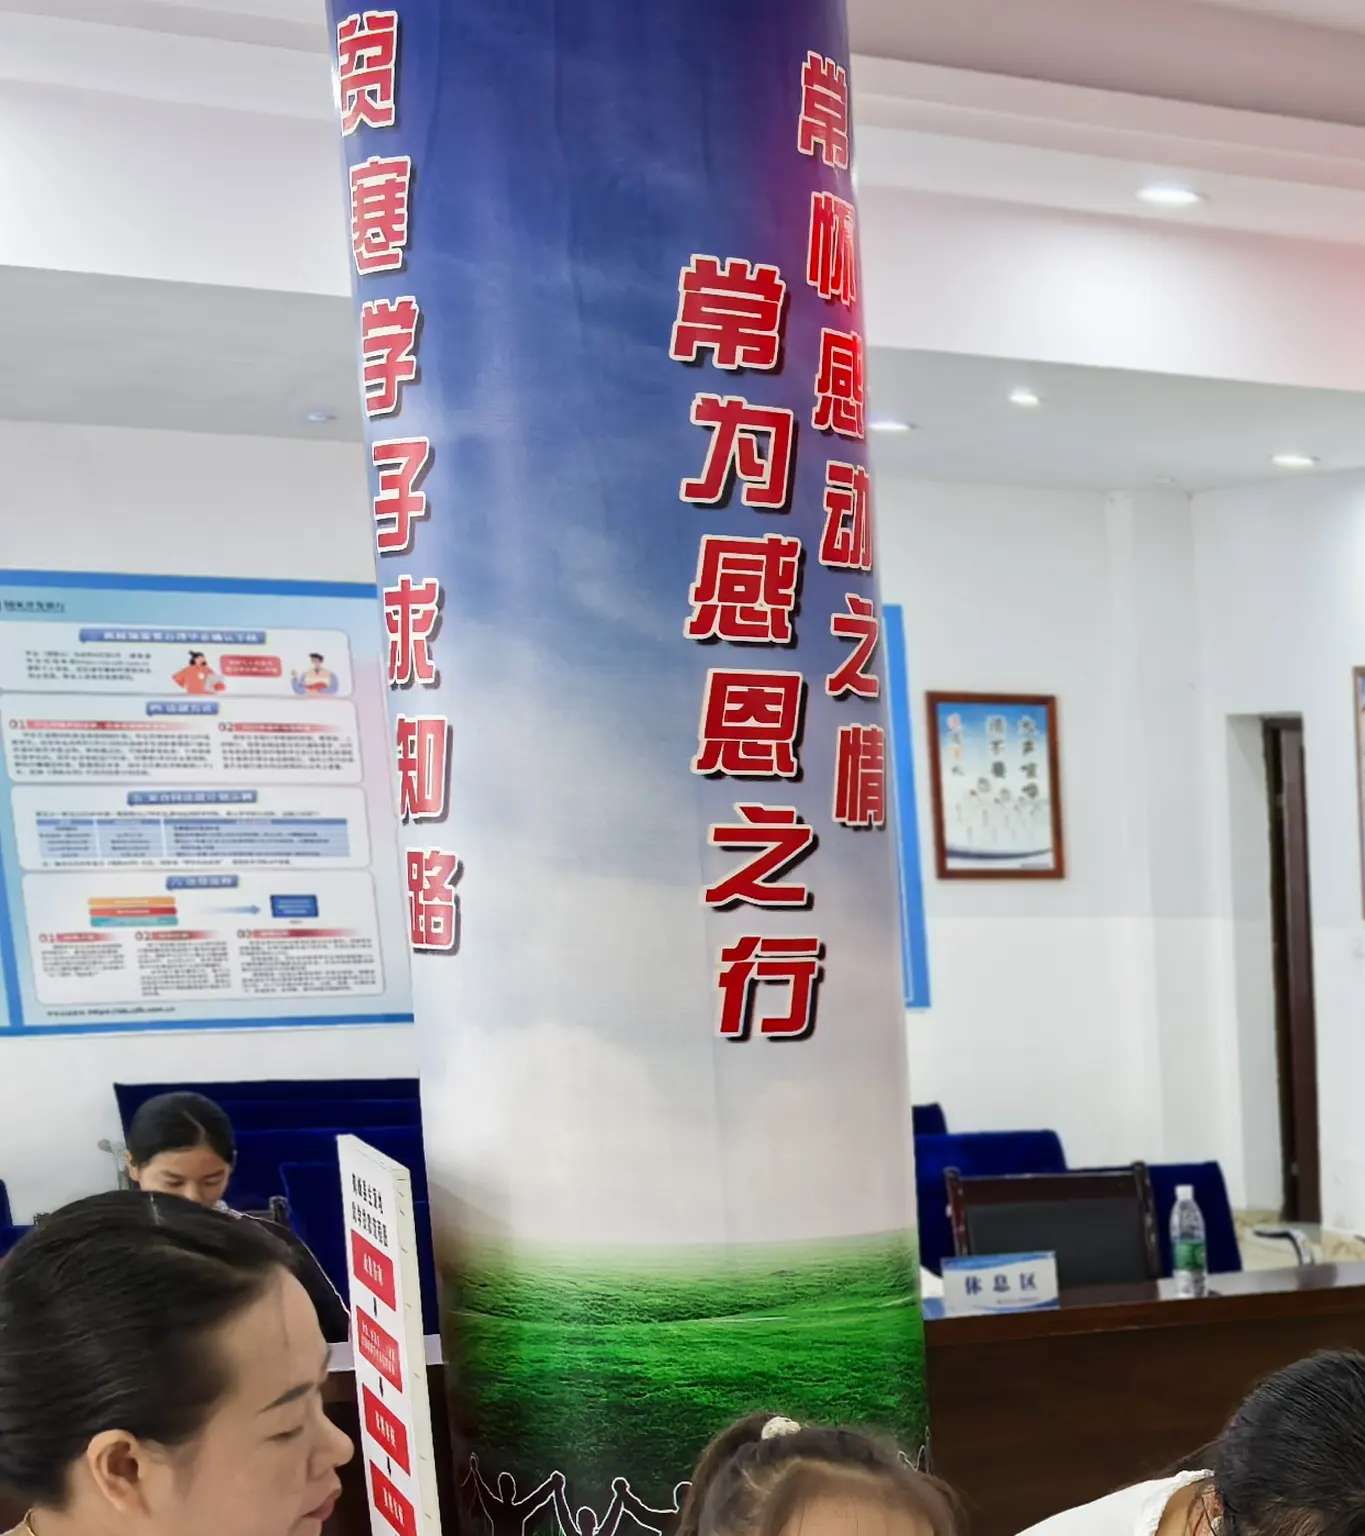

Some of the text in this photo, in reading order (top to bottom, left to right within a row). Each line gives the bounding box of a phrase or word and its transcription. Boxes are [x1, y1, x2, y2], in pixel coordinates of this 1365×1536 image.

[336, 10, 460, 951] 贫寒学子求知路
[669, 253, 821, 1038] 常为感恩之行
[797, 50, 887, 828] 常怀感动之情
[965, 1272, 1037, 1296] 休息区
